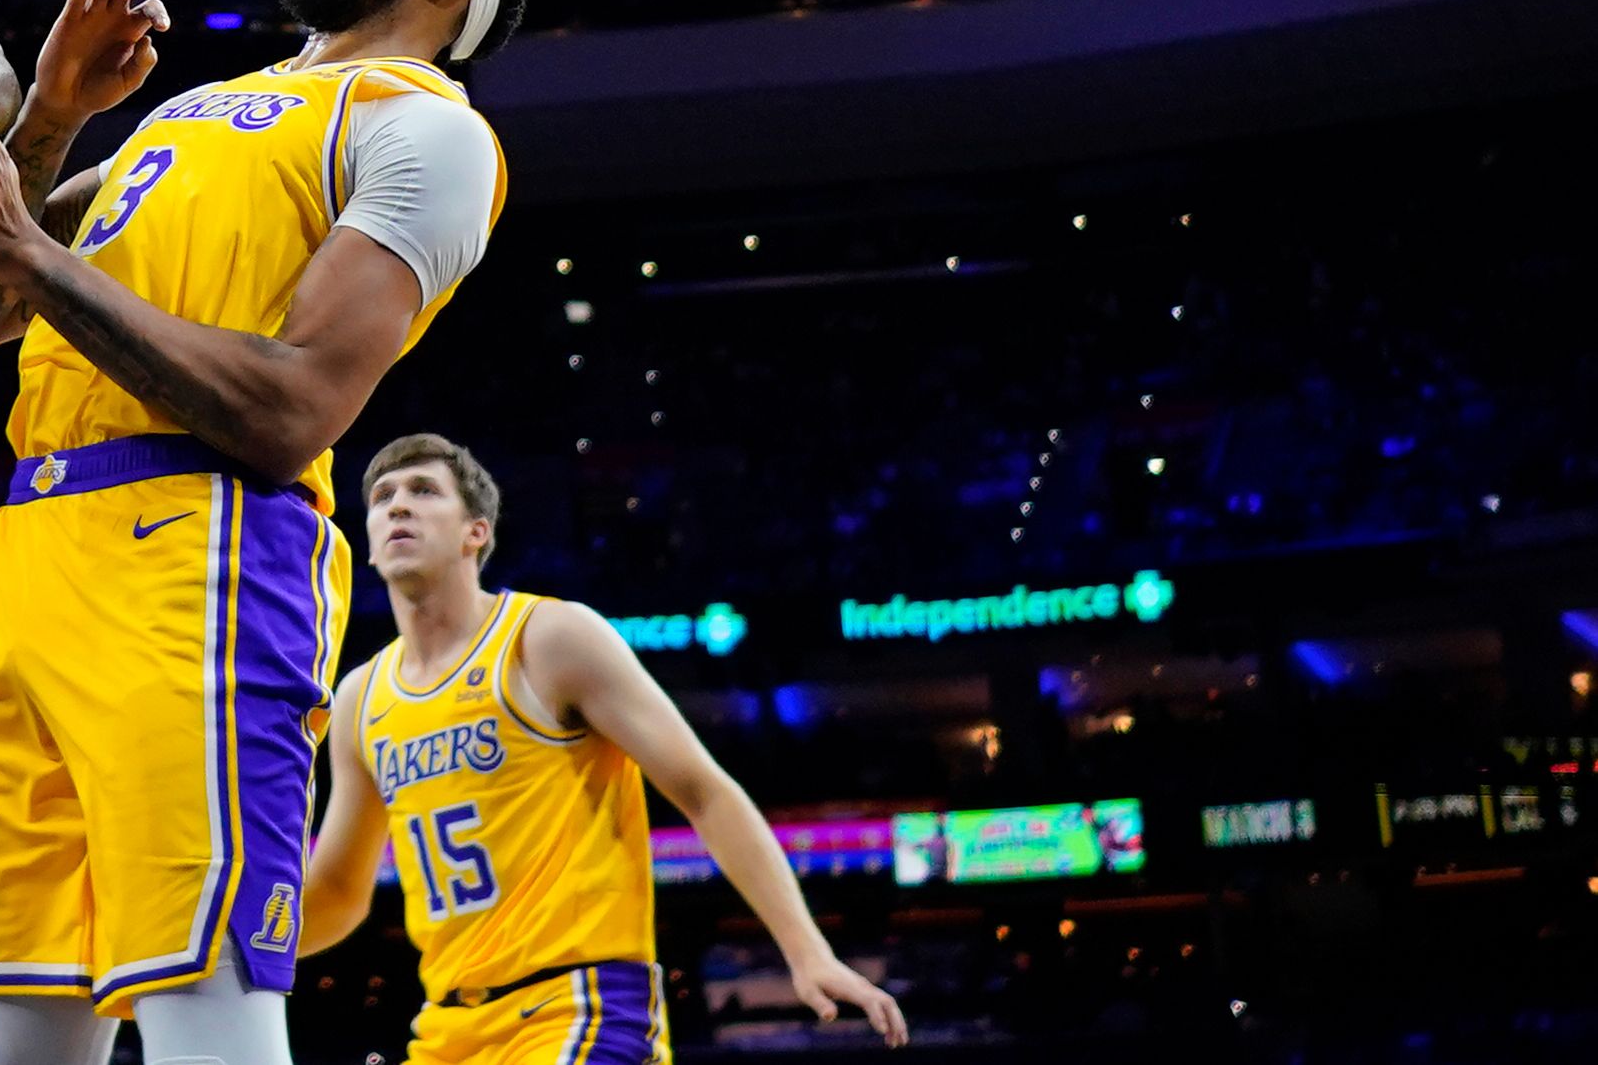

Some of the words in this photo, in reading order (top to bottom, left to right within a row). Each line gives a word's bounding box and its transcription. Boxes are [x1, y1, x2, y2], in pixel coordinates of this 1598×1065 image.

[77, 145, 175, 255] 3
[840, 584, 1119, 643] Independence
[372, 716, 507, 806] LAKERS
[406, 799, 501, 922] 15
